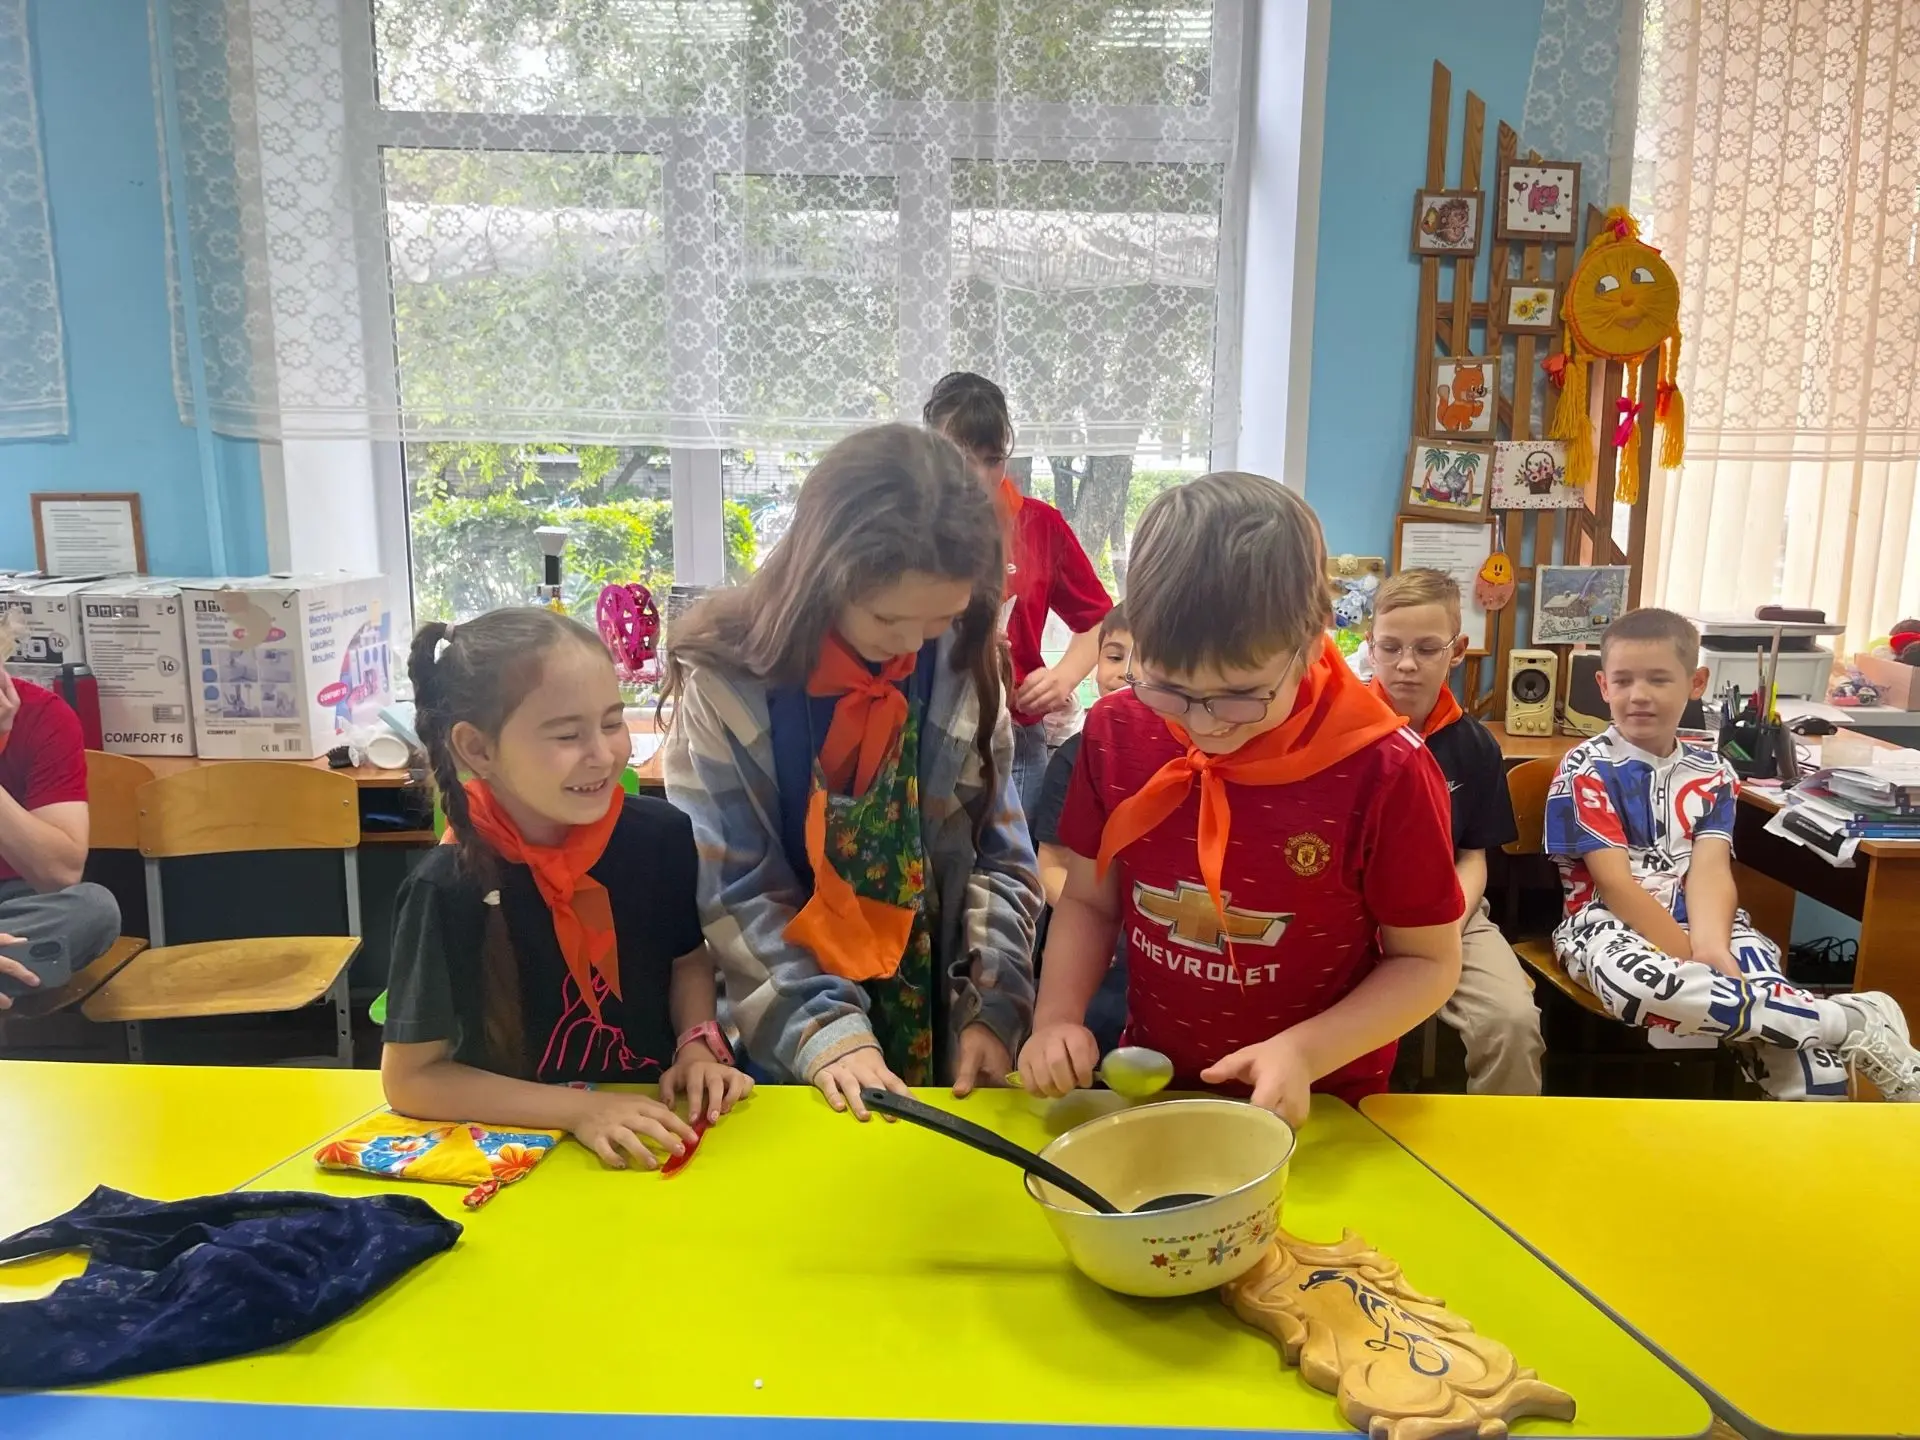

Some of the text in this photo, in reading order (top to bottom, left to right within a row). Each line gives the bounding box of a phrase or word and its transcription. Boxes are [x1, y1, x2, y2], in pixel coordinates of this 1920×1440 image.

[52, 637, 64, 648] 16
[161, 660, 174, 671] 16
[104, 732, 183, 744] COMFORT 16
[1131, 926, 1281, 986] CHEVROLET
